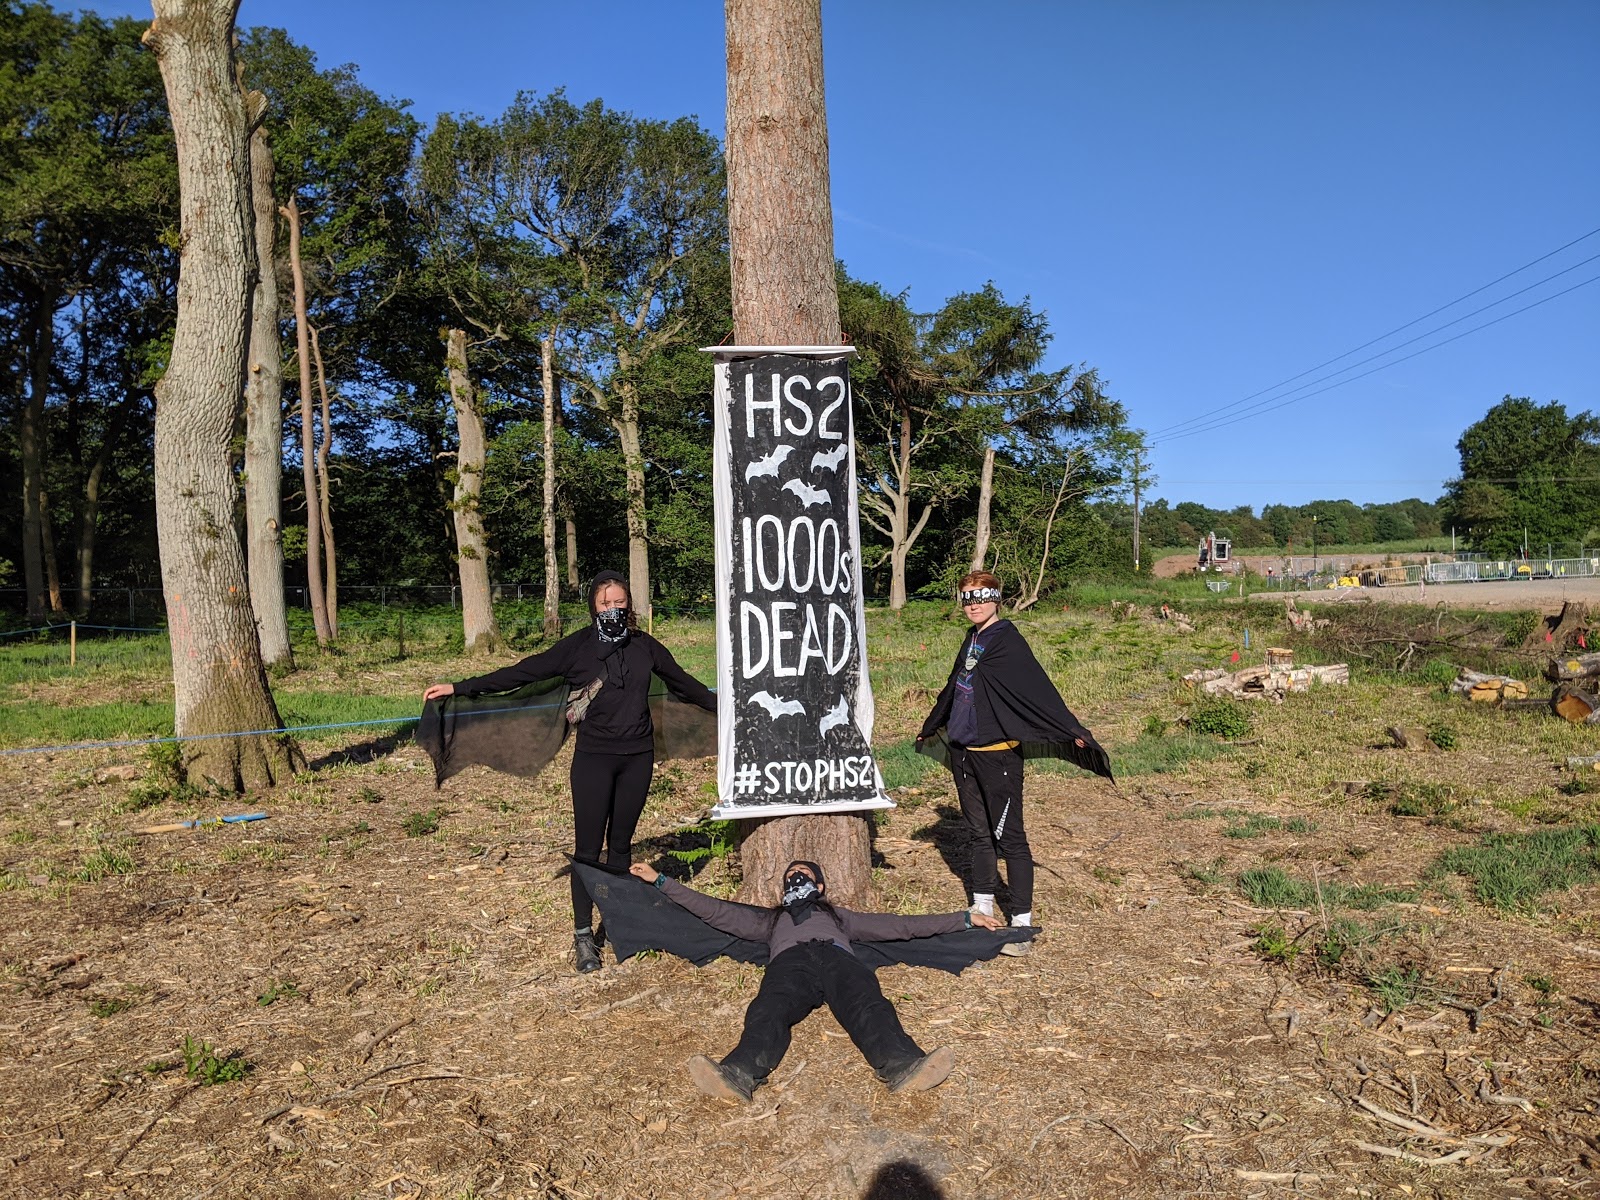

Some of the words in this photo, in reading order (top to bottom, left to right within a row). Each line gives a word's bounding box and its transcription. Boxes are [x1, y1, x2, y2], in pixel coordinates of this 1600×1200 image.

[745, 373, 846, 439] HS2
[742, 514, 851, 595] 1000s
[740, 600, 852, 679] DEAD
[734, 755, 872, 795] #STOPHS2
